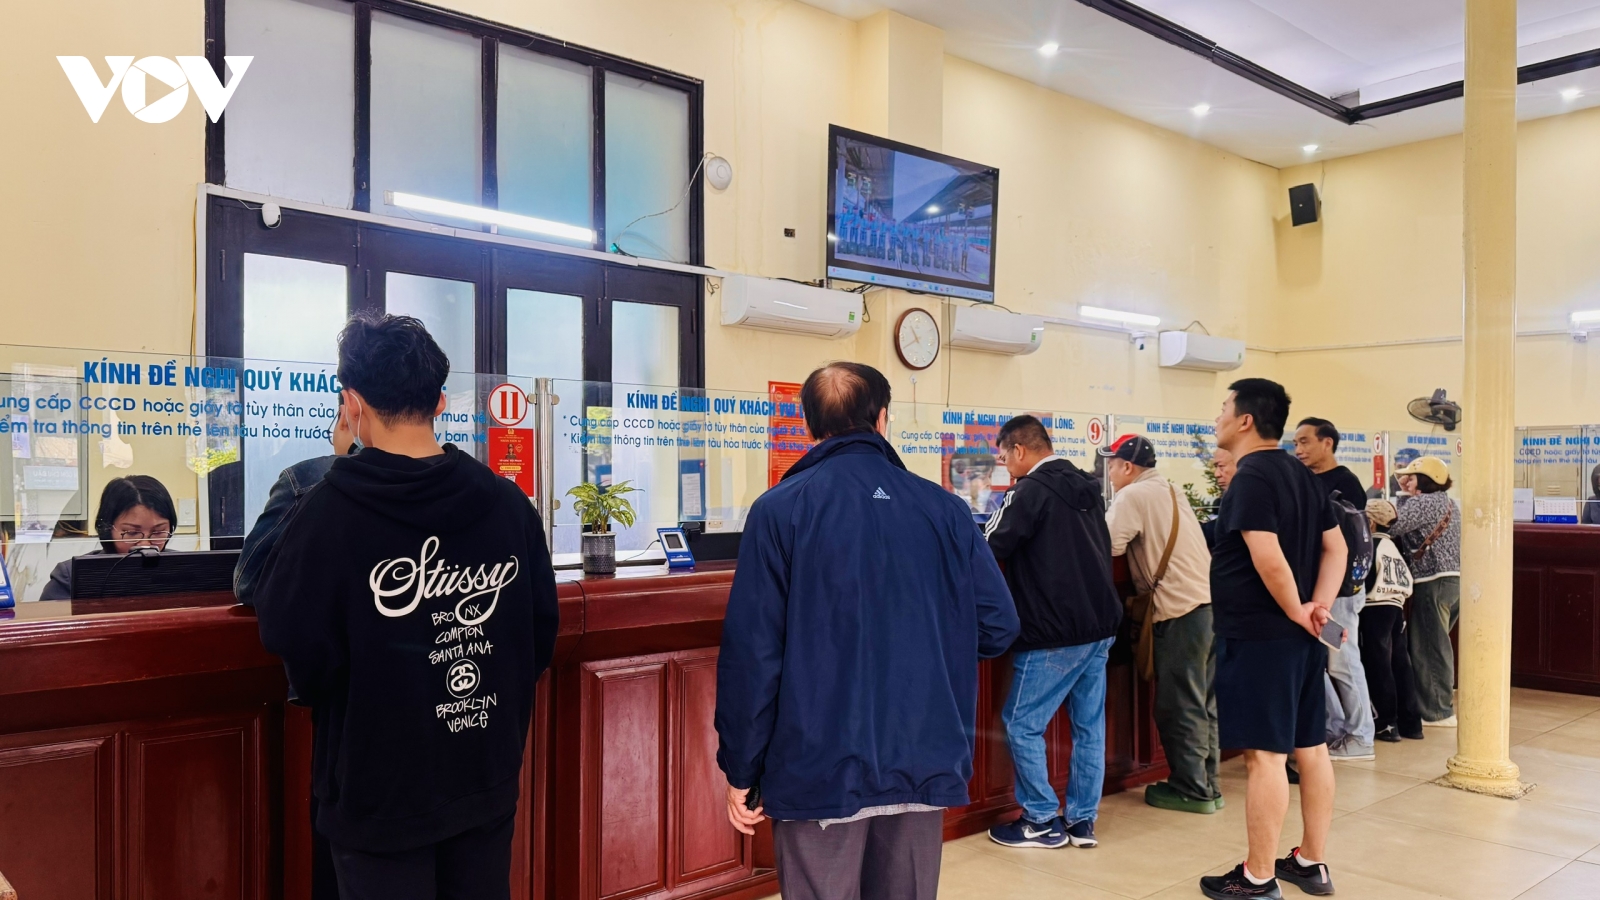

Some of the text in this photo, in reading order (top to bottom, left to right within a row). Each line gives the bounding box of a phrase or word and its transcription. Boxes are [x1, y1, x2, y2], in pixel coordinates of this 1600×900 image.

[84, 357, 343, 394] KÍNH ĐỀ NGHỊ QUÝ KHÁC
[0, 393, 334, 418] ung cấp CCCD hoặc giấy tờ tùy thân của
[499, 391, 520, 419] 11
[627, 390, 658, 410] KÍNH
[662, 390, 678, 410] ĐỀ
[681, 395, 710, 415] NGHỊ
[714, 396, 736, 415] QUÝ
[740, 397, 776, 416] KHÁCH
[441, 412, 468, 423] mua
[570, 415, 597, 429] Cung
[623, 419, 655, 429] CCCD
[658, 420, 681, 433] hoặc
[729, 423, 747, 434] thân
[749, 423, 765, 434] của
[943, 409, 962, 424] KÍNH
[0, 414, 28, 433] ểm
[33, 419, 57, 434] tra
[62, 420, 112, 439] thông
[117, 420, 137, 435] tin
[142, 422, 172, 437] trên
[177, 421, 202, 437] thẻ
[206, 424, 230, 437] lên
[263, 423, 290, 438] hỏa
[295, 425, 331, 439] trước
[902, 431, 919, 441] Cung
[1090, 422, 1101, 441] 9
[614, 434, 641, 447] thông
[643, 435, 653, 445] tin
[657, 435, 674, 446] trên
[435, 625, 484, 644] COMPTON
[466, 640, 493, 655] ANA
[435, 693, 497, 719] BROOKLYN
